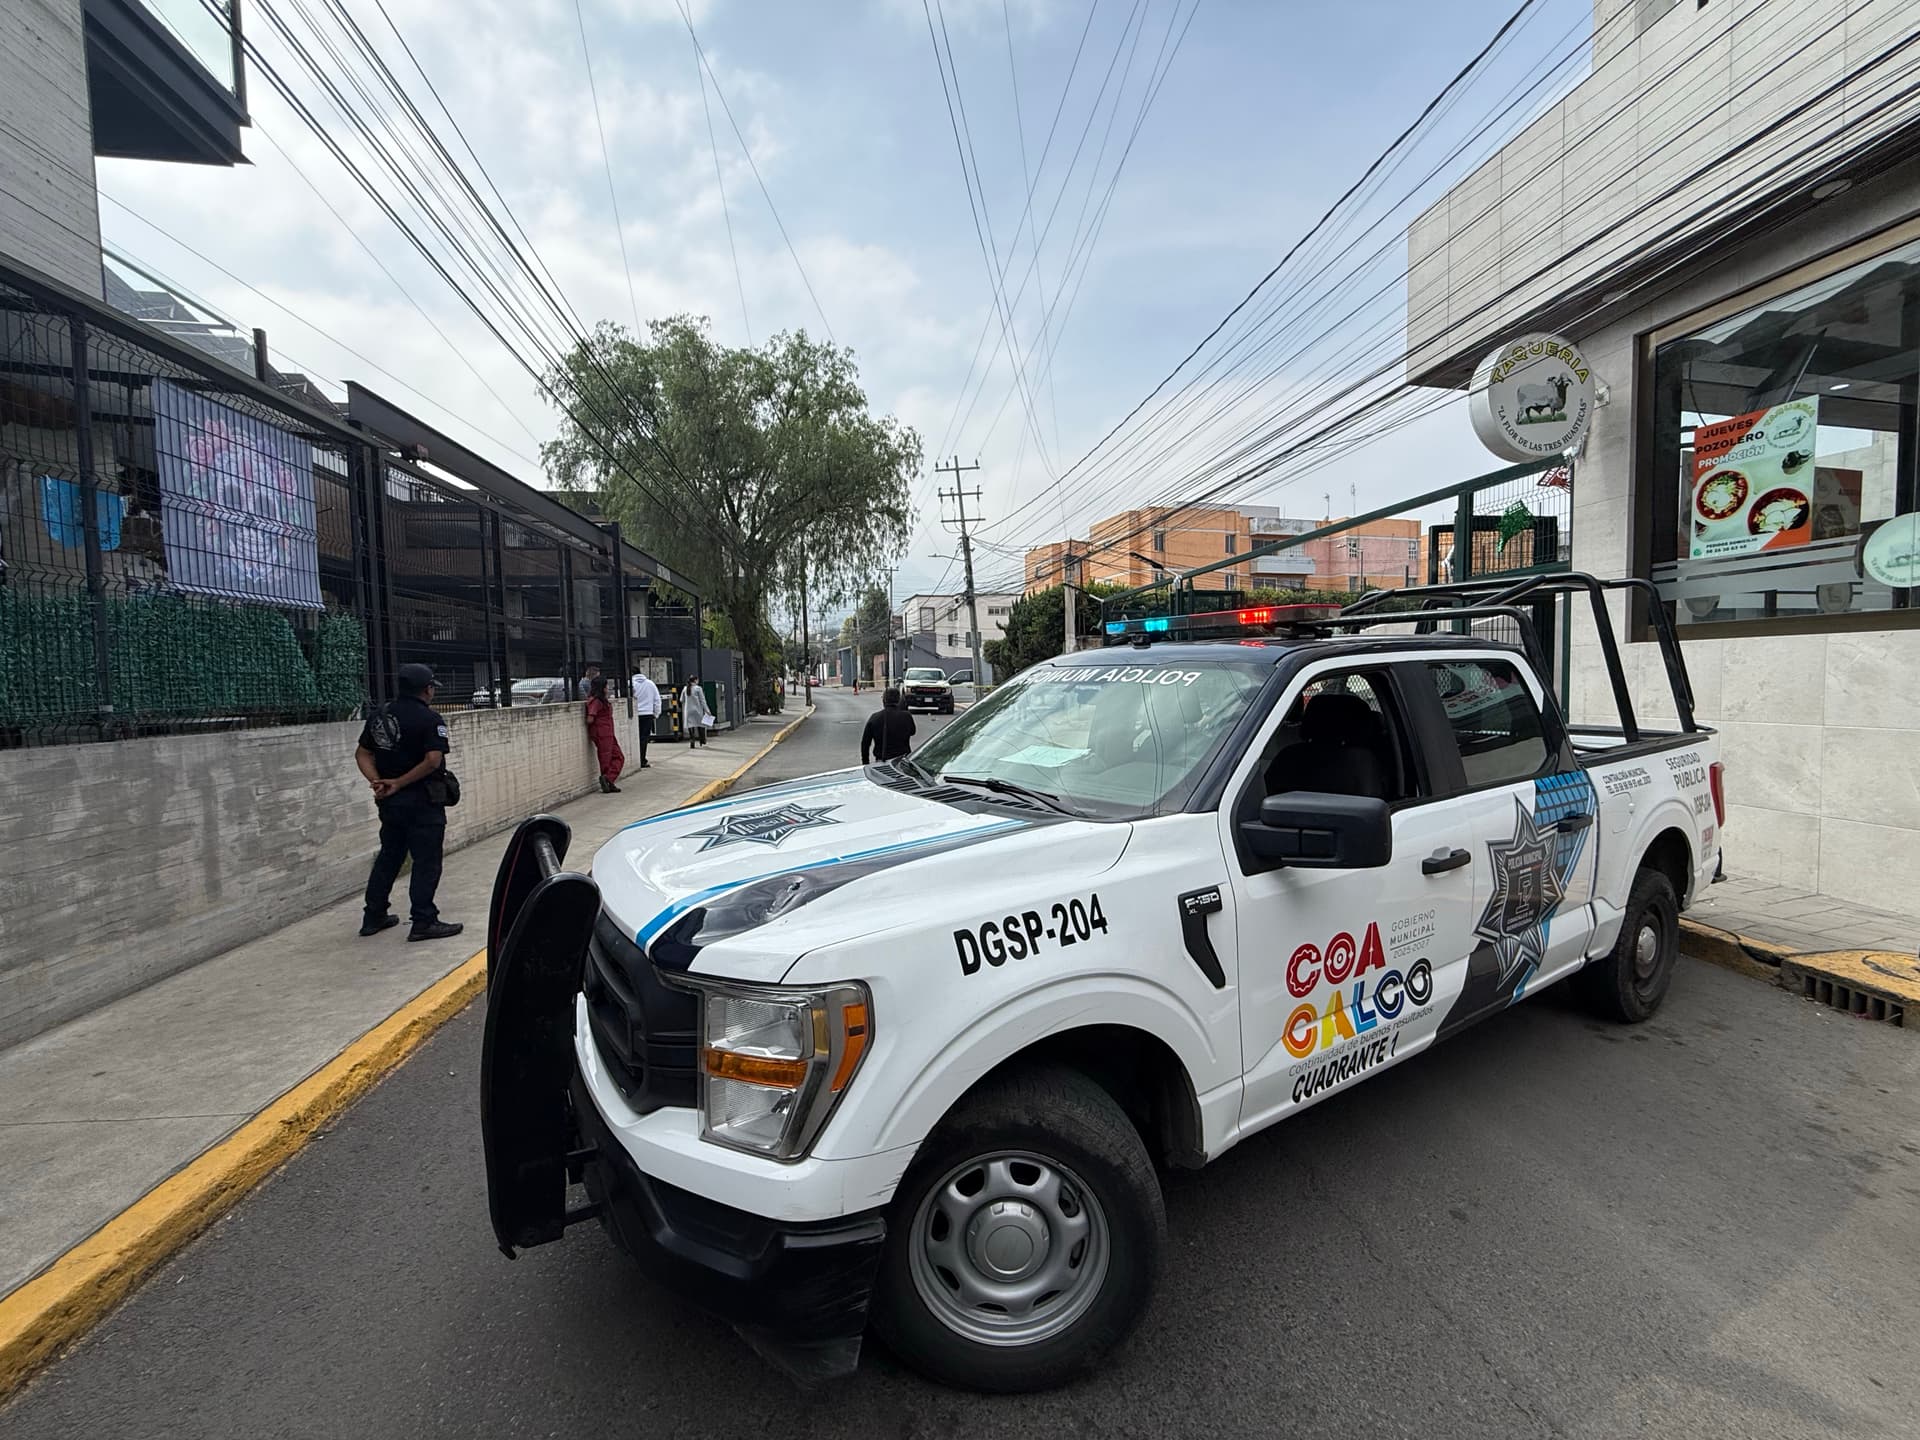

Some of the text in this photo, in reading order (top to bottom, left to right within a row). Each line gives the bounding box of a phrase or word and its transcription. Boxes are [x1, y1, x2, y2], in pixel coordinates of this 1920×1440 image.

[1491, 341, 1590, 385] TAQUERIA
[1502, 421, 1519, 440] FLOR
[1518, 437, 1529, 448] DE
[1528, 442, 1543, 452] LAS
[1543, 440, 1562, 452] TRES
[1695, 430, 1765, 455] POZOLERO
[1702, 418, 1754, 439] JUEVES
[1698, 443, 1766, 469] PROMOCIÓN
[1665, 752, 1700, 770] SEGURIDAD
[953, 893, 1109, 977] DGSP-204
[1390, 922, 1435, 946] MUNICIPAL
[1391, 909, 1435, 932] GOBIERNO
[1285, 921, 1386, 998] COA
[1281, 957, 1434, 1060] CALCO
[1289, 1005, 1435, 1077] Continuidad de buenos resultados
[1292, 1030, 1400, 1104] CUADRANTE 1
